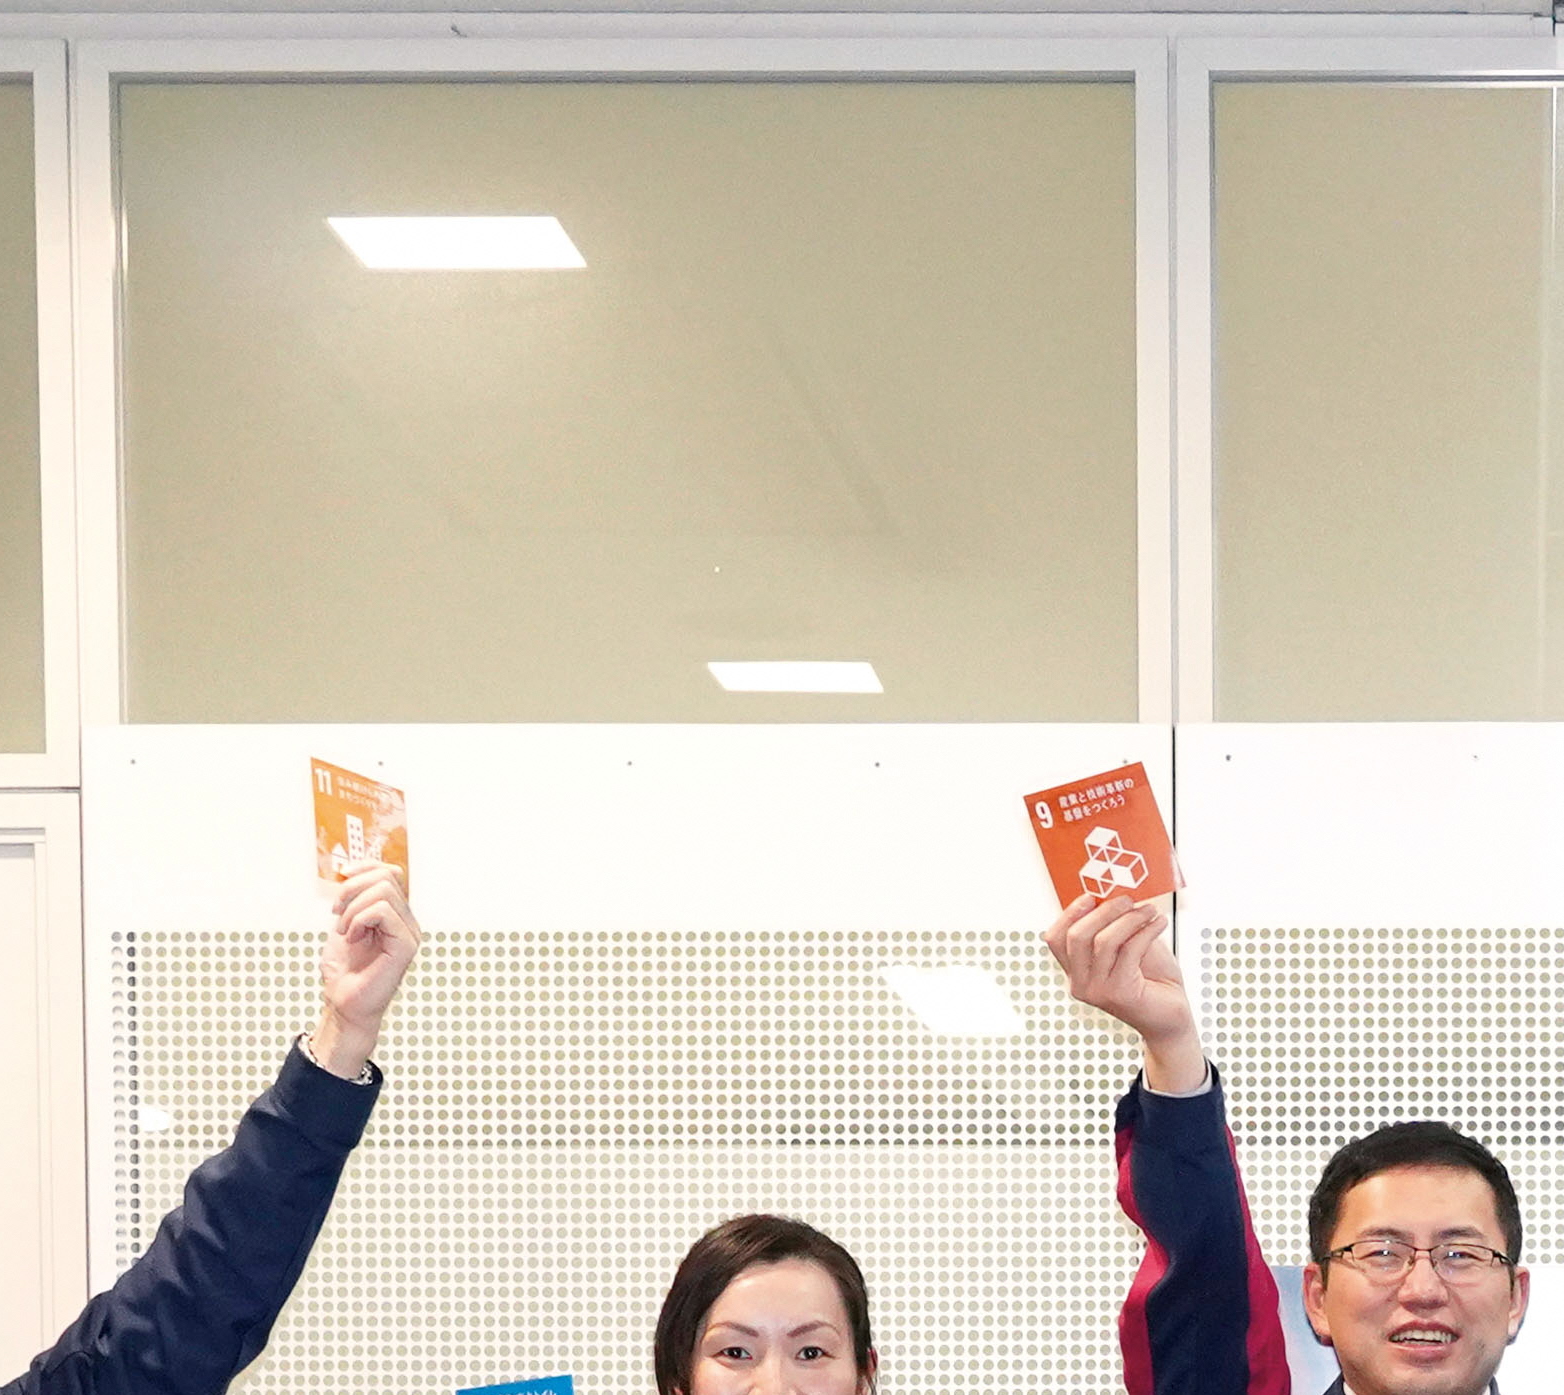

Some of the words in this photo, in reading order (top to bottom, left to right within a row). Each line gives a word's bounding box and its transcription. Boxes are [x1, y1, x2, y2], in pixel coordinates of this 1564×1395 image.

[314, 767, 333, 796] 11
[1058, 778, 1134, 809] 産業と技術革新の
[1035, 800, 1054, 829] 9
